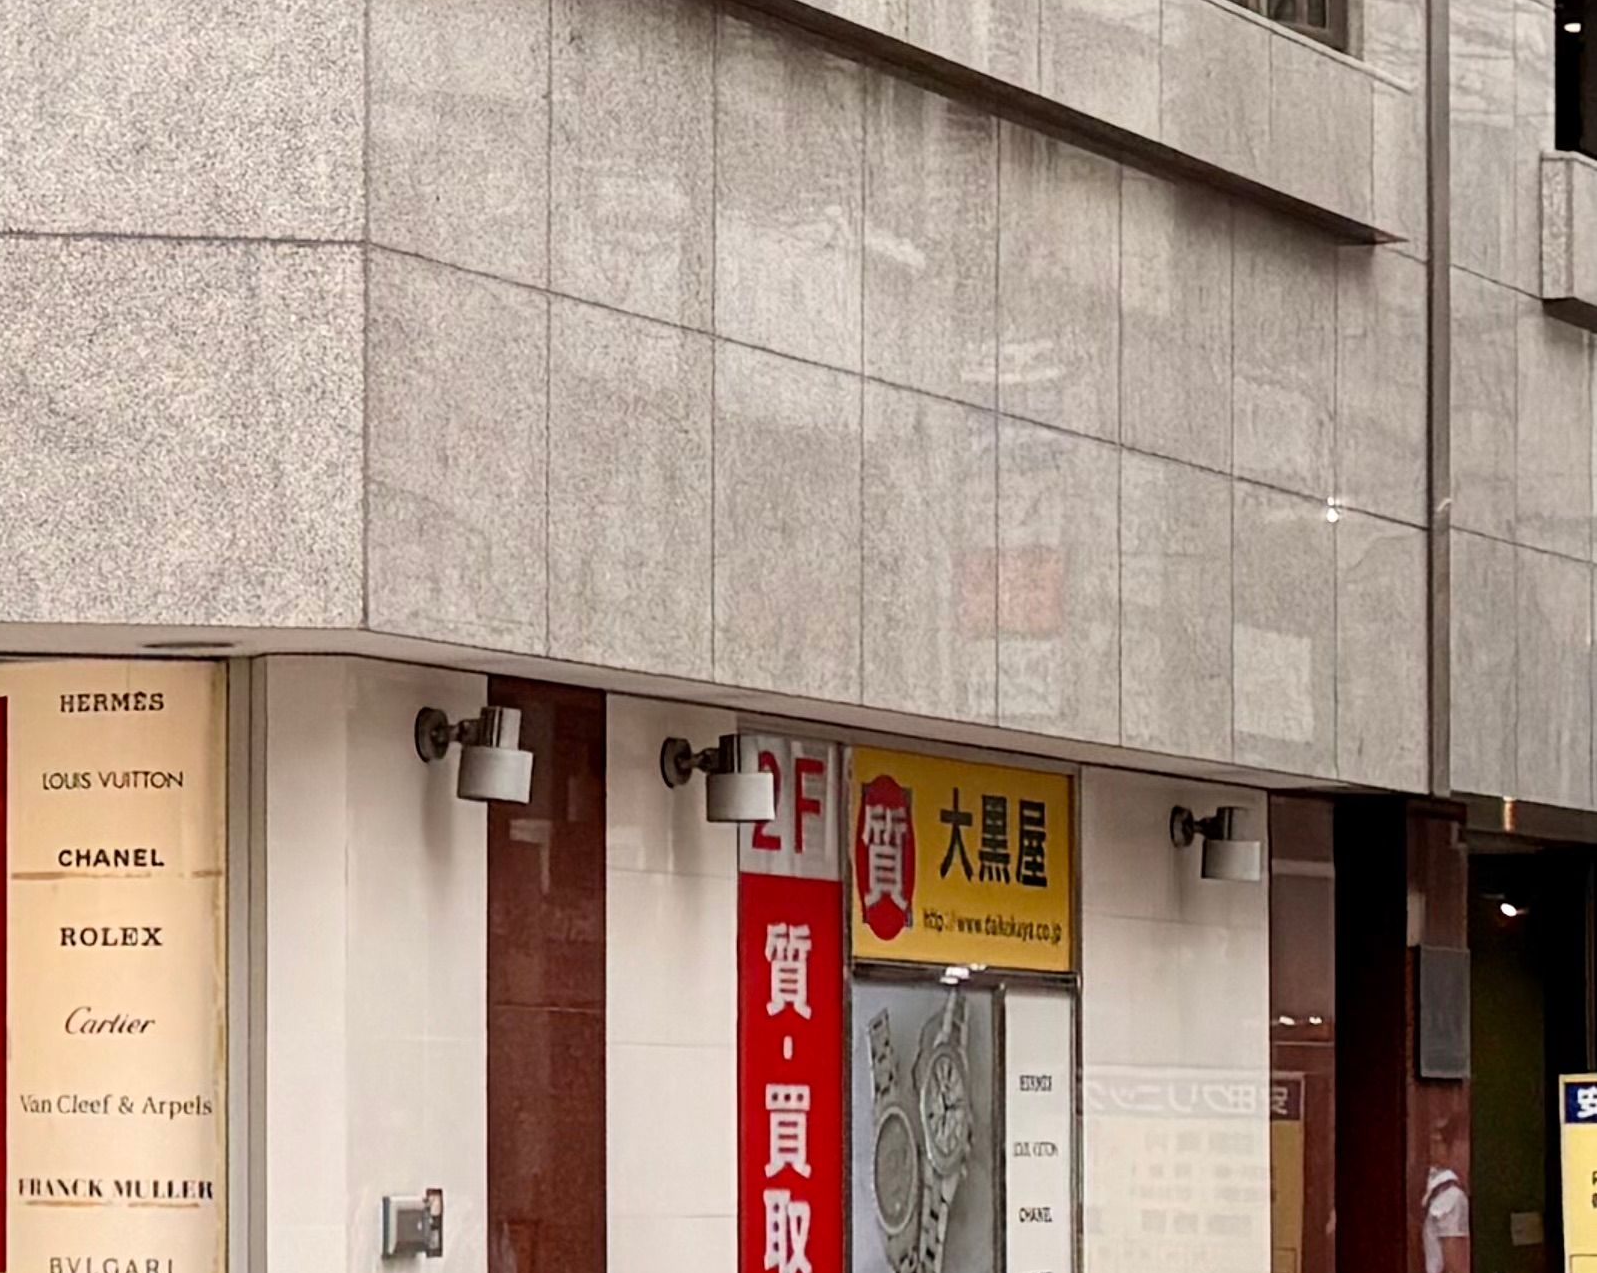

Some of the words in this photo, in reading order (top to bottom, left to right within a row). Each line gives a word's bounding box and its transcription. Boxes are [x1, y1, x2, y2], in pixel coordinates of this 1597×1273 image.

[42, 771, 91, 790] LOUIS
[98, 770, 184, 789] VUITTON
[752, 750, 824, 854] 2F
[940, 787, 1047, 888] 大黒屋
[58, 848, 165, 868] CHANEL
[863, 804, 907, 910] 質
[60, 927, 163, 947] ROLEX
[64, 1006, 156, 1035] Cartier
[20, 1094, 52, 1114] Van
[57, 1093, 112, 1115] Cleef
[118, 1096, 134, 1114] &
[142, 1094, 213, 1120] Arpels
[18, 1179, 103, 1199] FRANCK
[113, 1179, 214, 1200] MULLER
